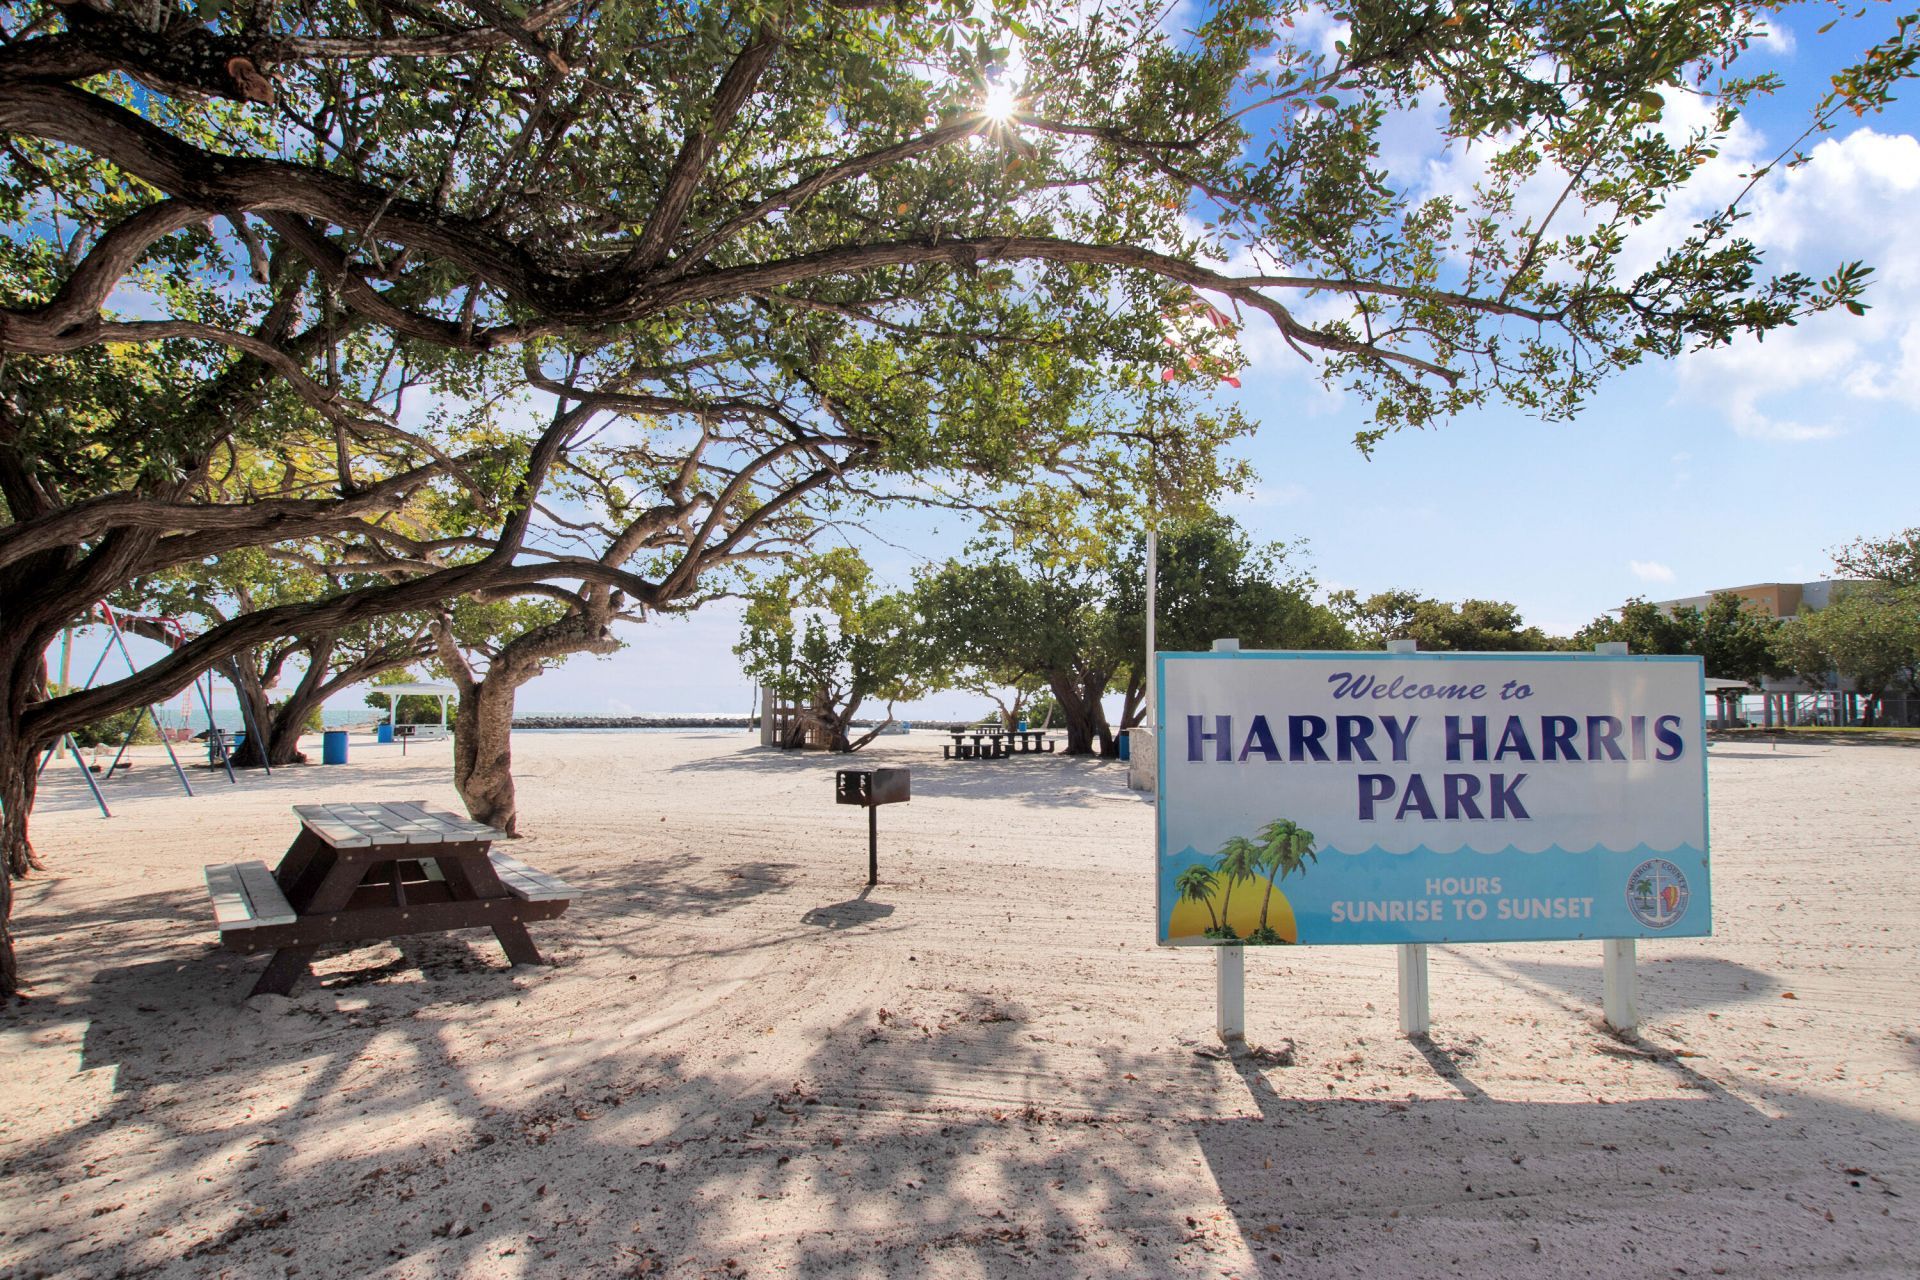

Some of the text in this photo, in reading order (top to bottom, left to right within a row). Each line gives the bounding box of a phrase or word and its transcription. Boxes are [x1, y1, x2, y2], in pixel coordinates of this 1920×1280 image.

[1327, 671, 1534, 701] Welcome to
[1187, 714, 1684, 763] HARRY HARRIS
[1357, 773, 1532, 821] PARK
[1425, 877, 1503, 897] HOURS
[1628, 862, 1686, 891] MONROE COUNTY
[1331, 897, 1595, 923] SUNRISE TO SUNSET
